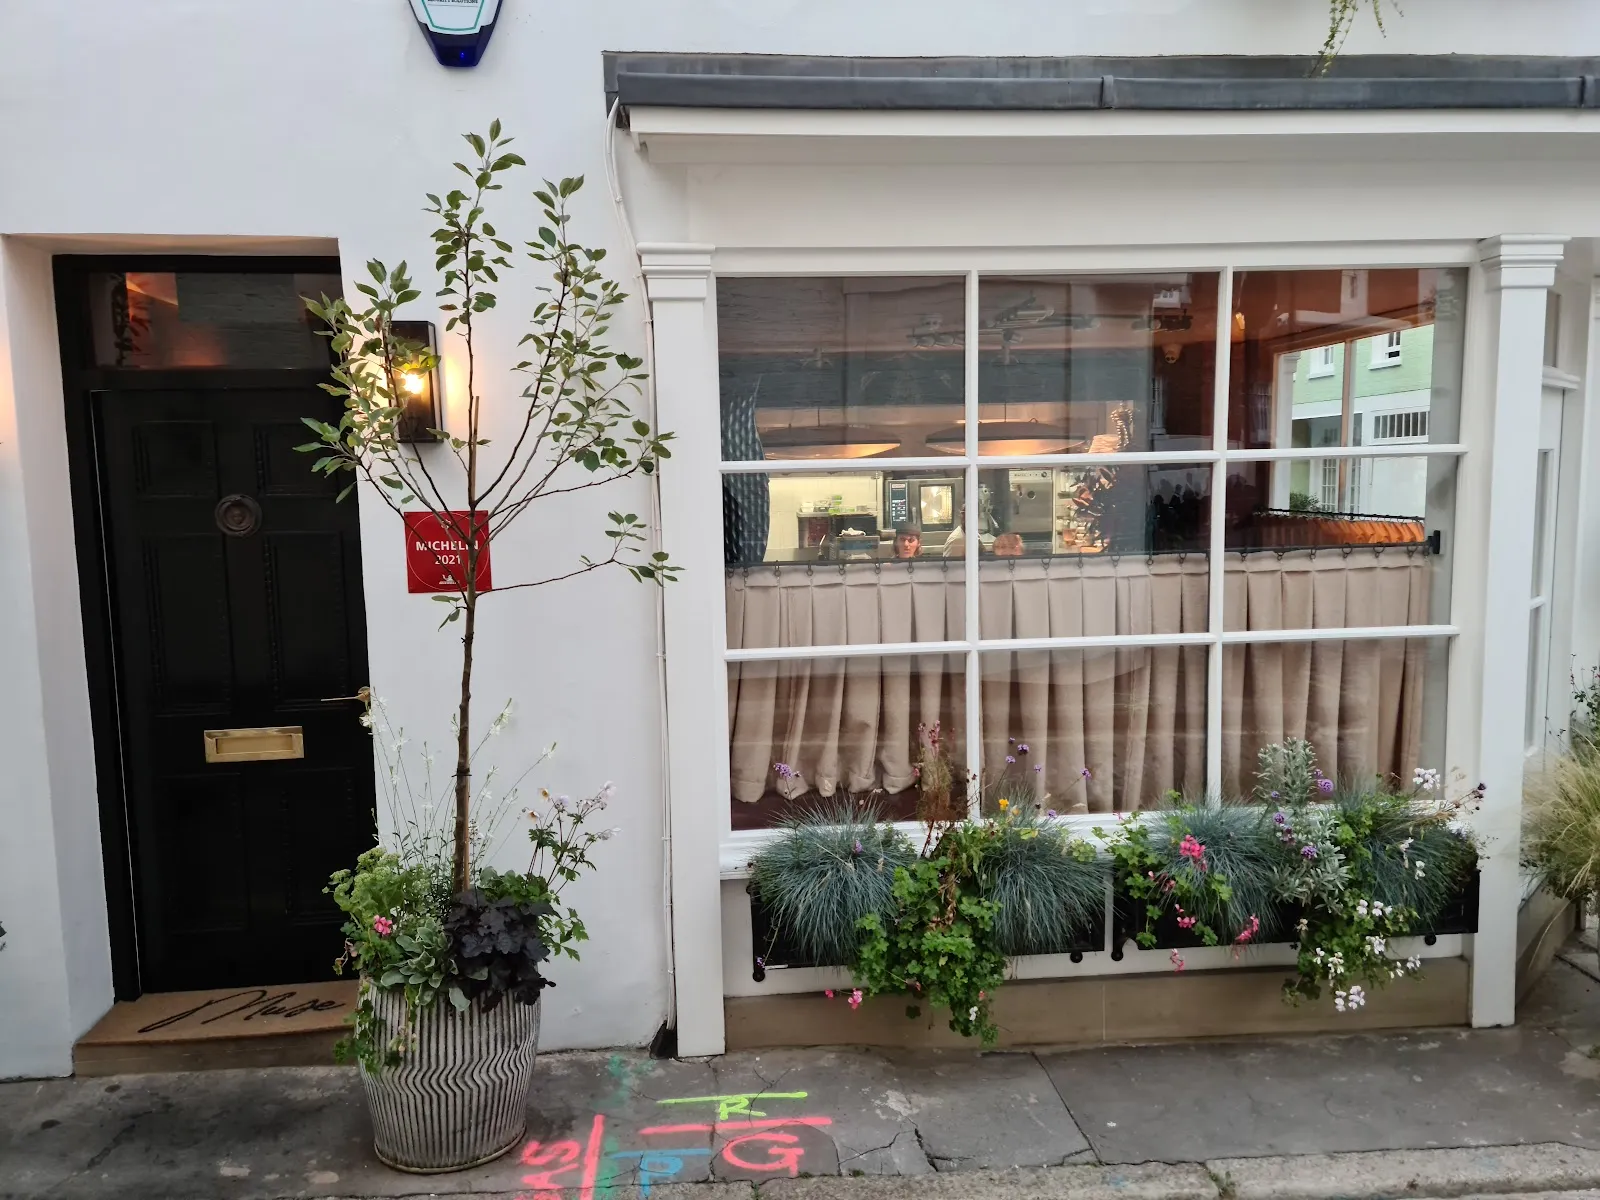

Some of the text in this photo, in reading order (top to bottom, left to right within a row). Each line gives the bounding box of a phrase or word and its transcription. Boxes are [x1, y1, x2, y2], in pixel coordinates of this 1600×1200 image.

[434, 554, 461, 565] 2021
[514, 1140, 580, 1200] AS
[722, 1132, 805, 1177] G
